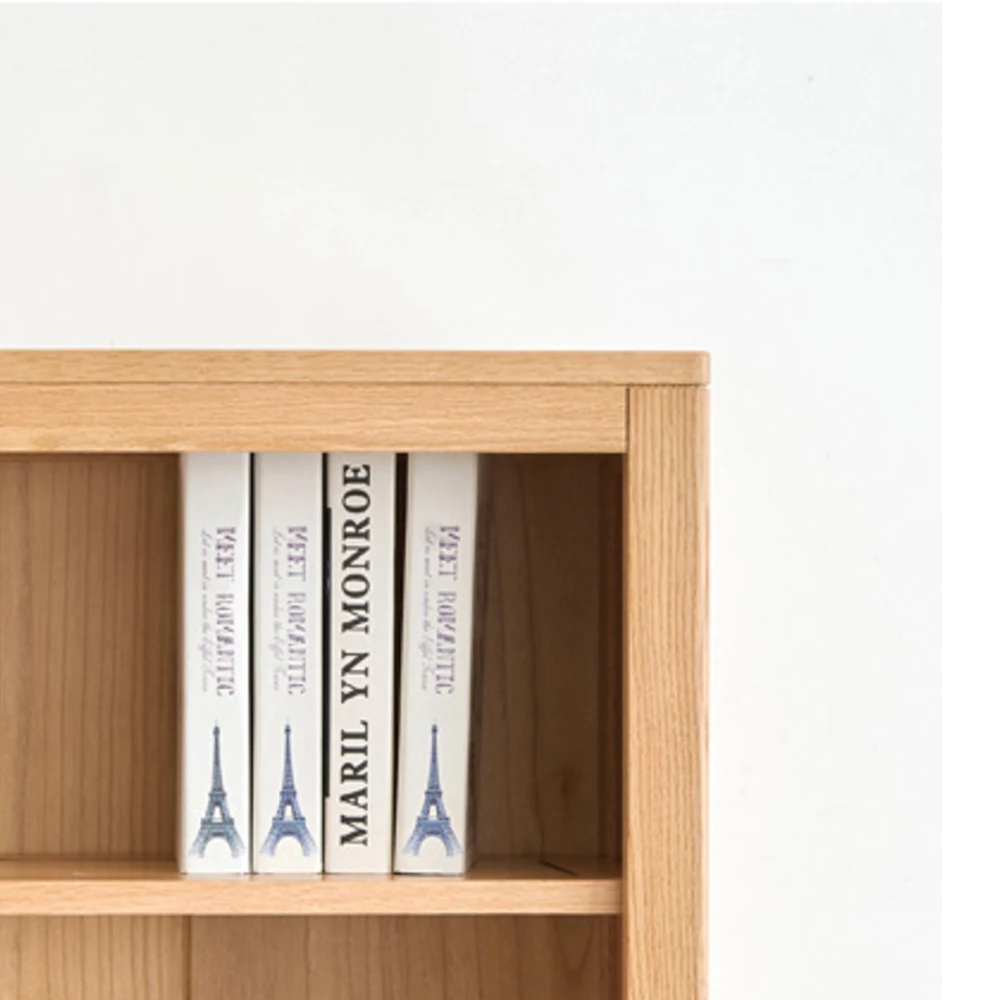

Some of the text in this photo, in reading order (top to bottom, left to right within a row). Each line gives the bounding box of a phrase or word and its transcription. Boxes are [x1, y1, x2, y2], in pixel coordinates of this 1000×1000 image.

[214, 593, 236, 697] ROMANTIC
[286, 592, 307, 696] ROMANTIC
[339, 463, 371, 847] MARIL YN MONROE
[435, 591, 457, 695] ROMANTIC
